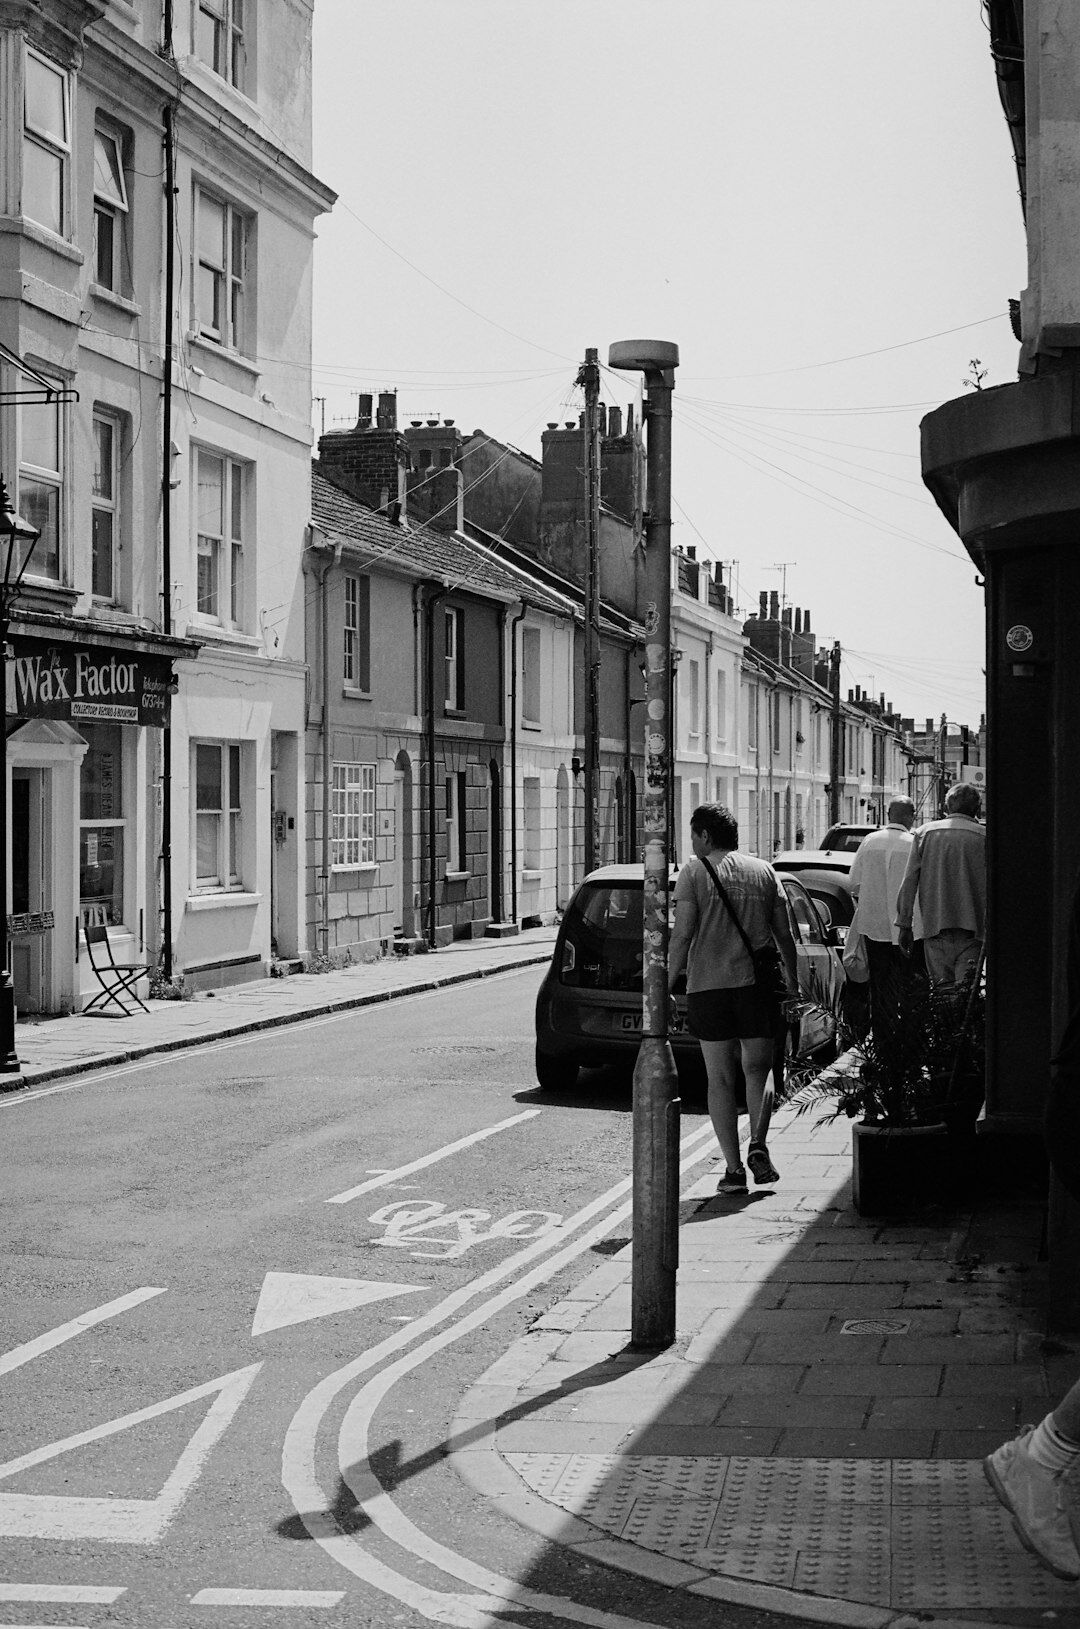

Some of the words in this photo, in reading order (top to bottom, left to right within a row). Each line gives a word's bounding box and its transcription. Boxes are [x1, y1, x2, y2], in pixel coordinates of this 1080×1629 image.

[16, 656, 70, 706] Wax
[73, 651, 139, 698] Factor
[98, 706, 113, 717] RECORD
